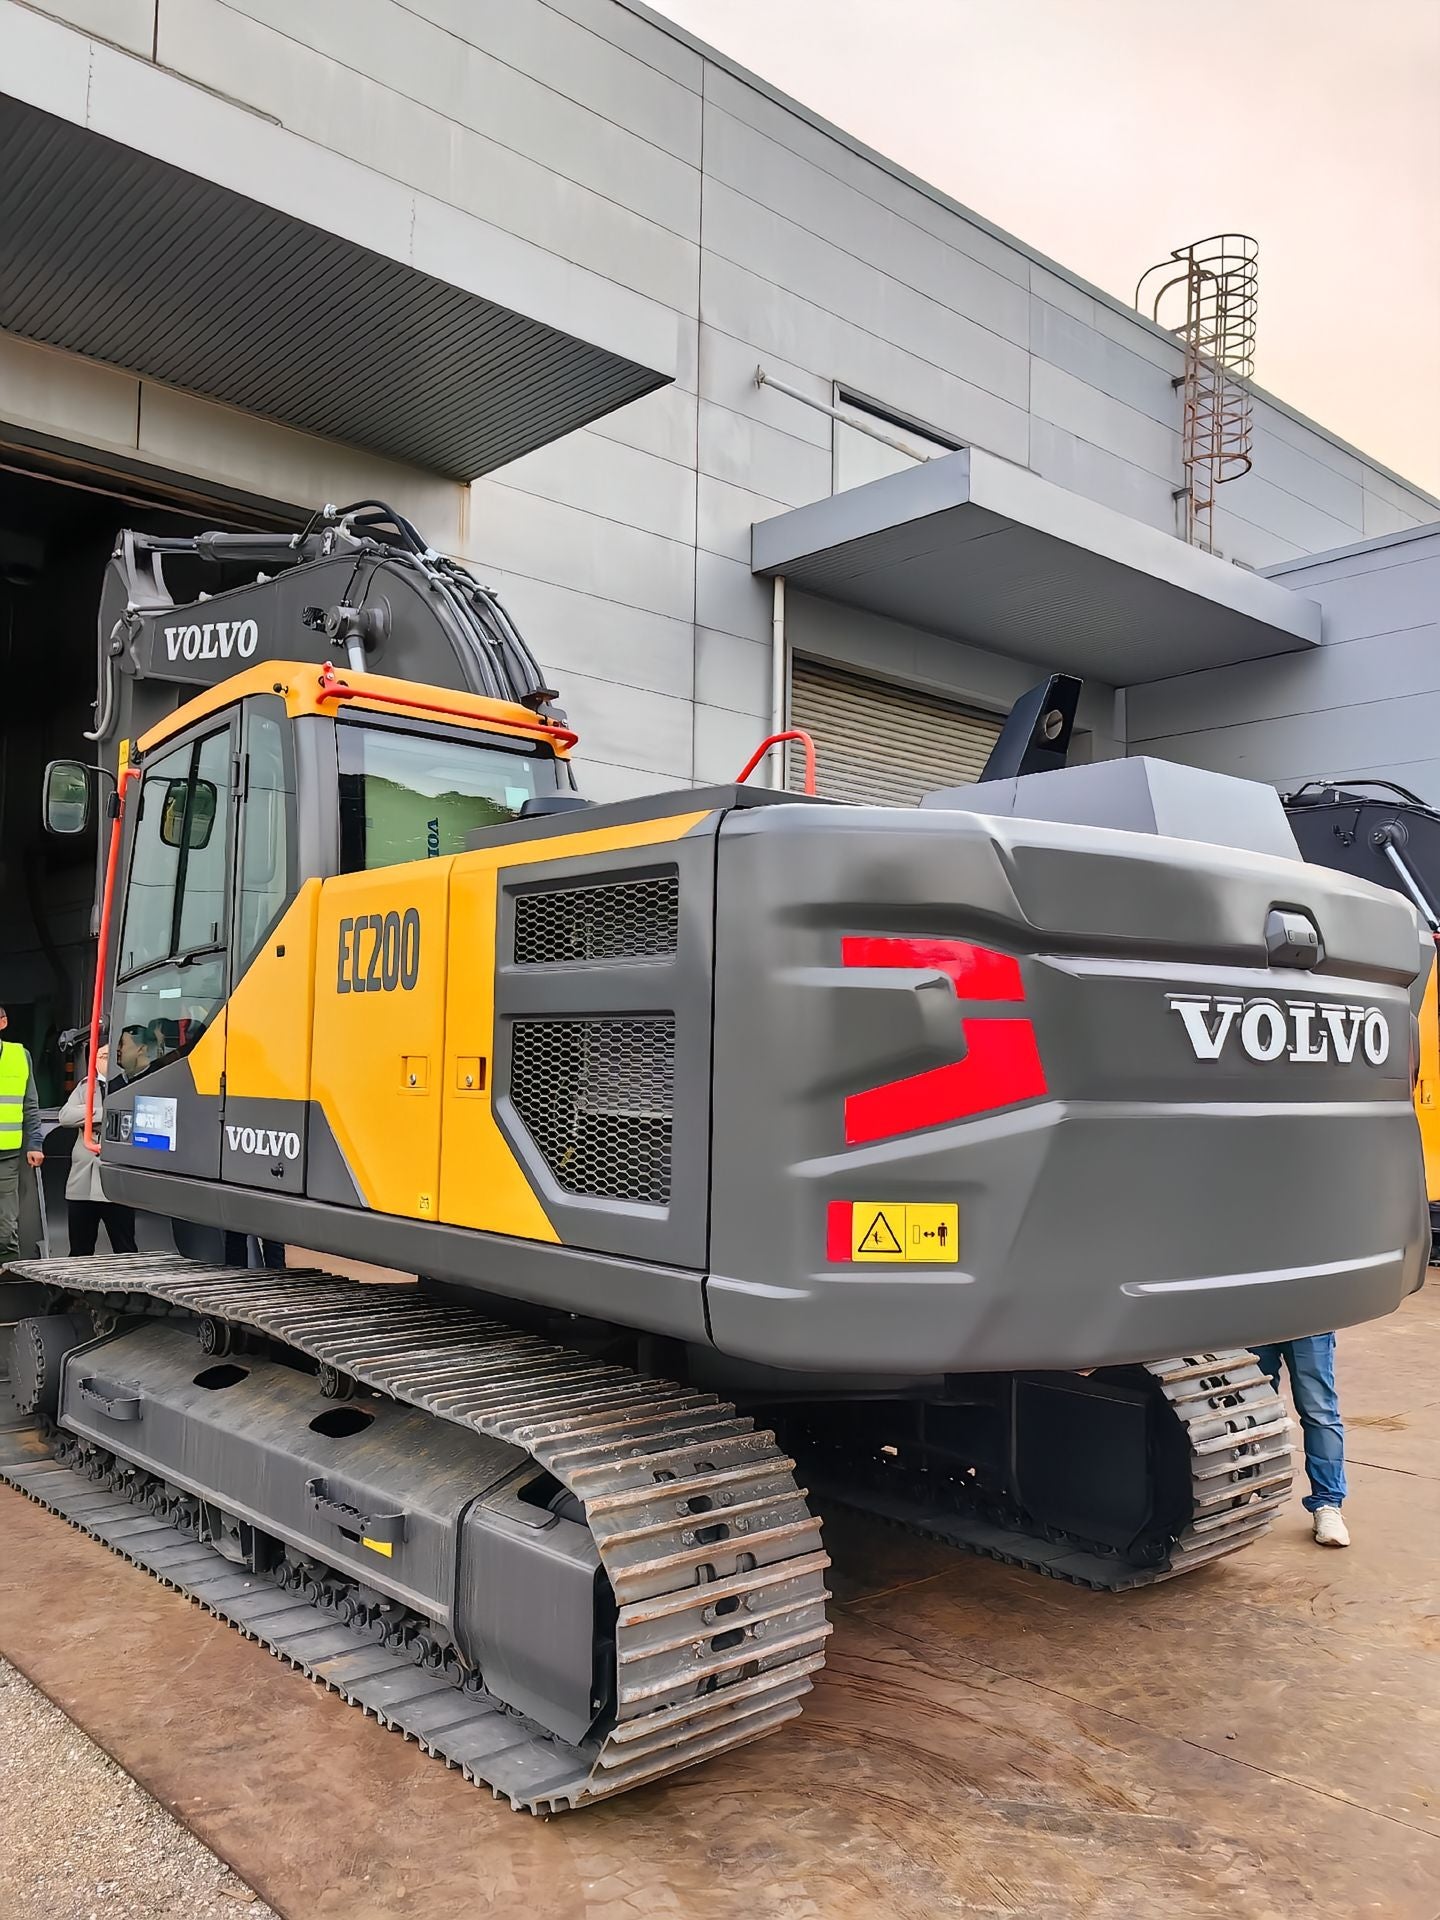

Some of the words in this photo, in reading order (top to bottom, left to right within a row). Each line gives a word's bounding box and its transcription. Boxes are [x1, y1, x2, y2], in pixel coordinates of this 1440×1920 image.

[164, 619, 258, 661] VOLVO
[337, 908, 420, 994] EC200
[1166, 994, 1390, 1065] VOLVO
[225, 1125, 300, 1160] VOLVO
